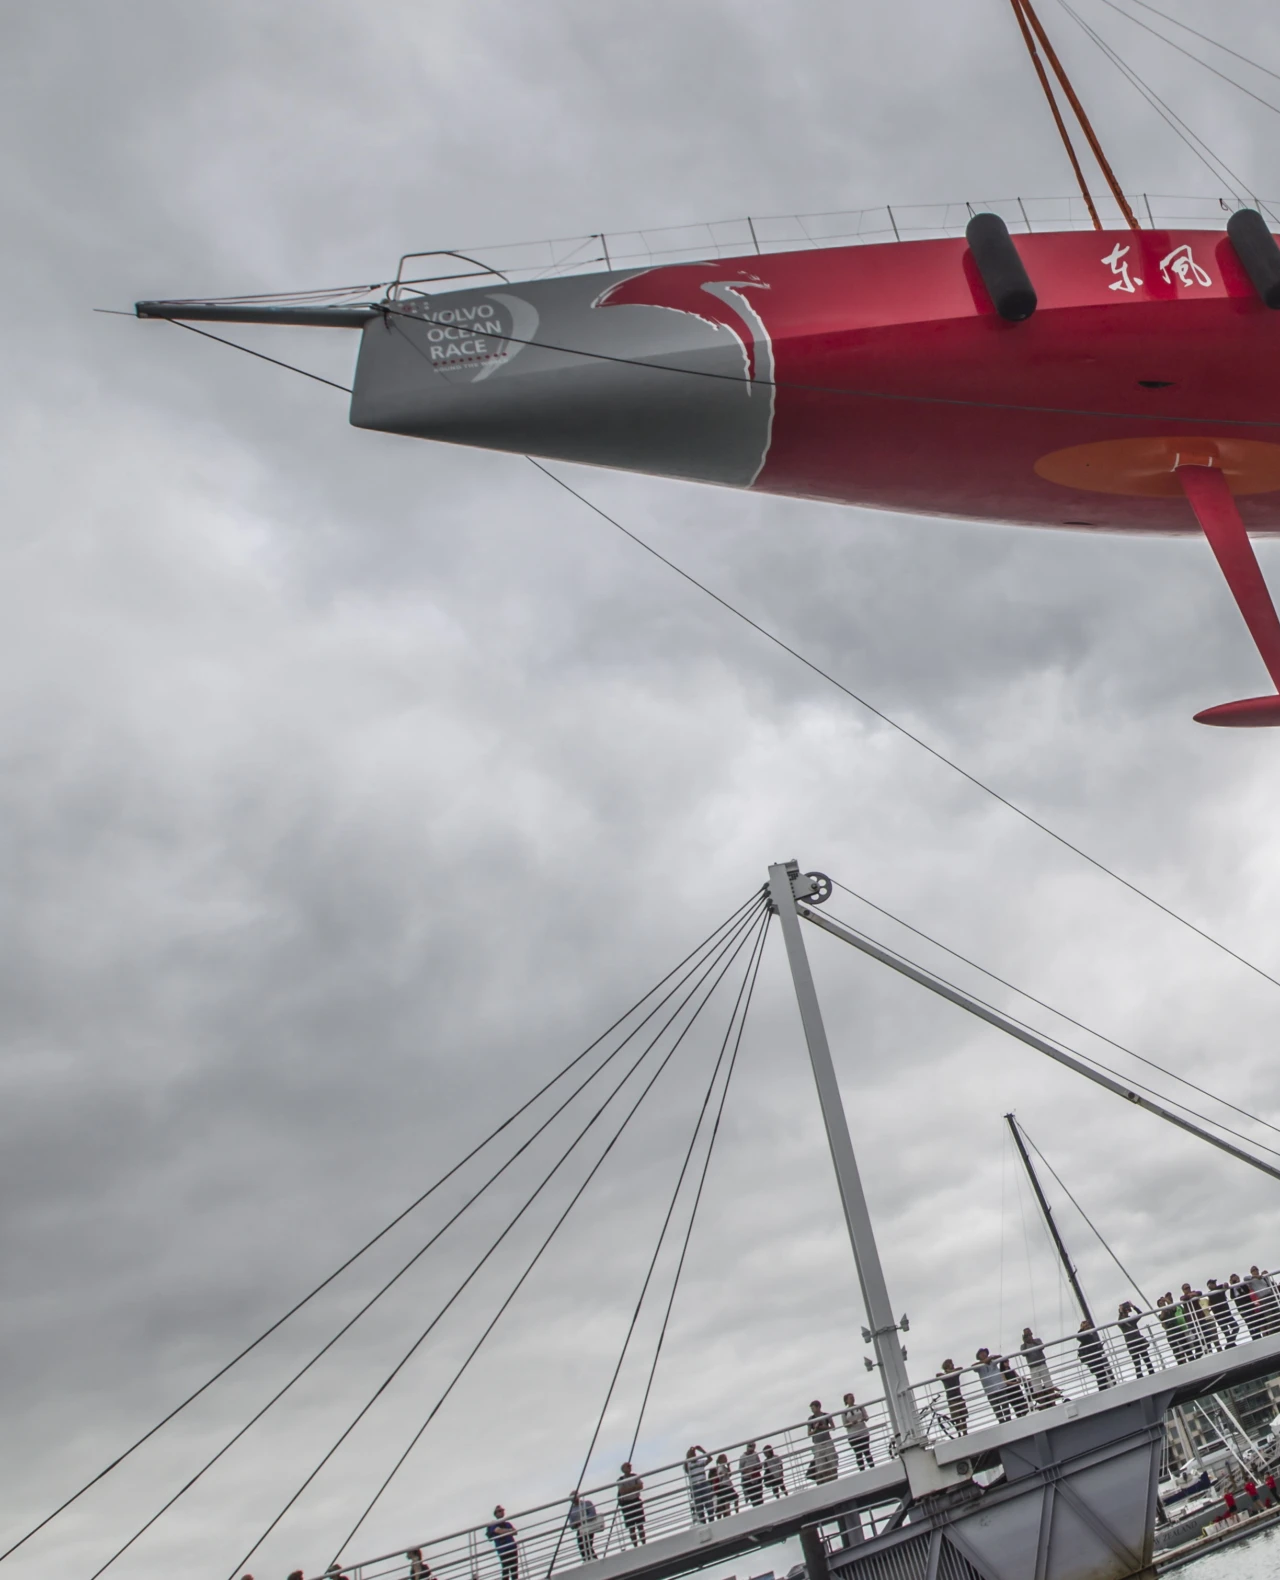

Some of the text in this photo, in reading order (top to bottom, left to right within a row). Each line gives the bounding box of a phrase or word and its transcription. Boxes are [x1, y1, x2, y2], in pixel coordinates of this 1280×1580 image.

[423, 305, 494, 326] VOLVO
[427, 320, 502, 342] OCEAN
[430, 339, 487, 360] RACE
